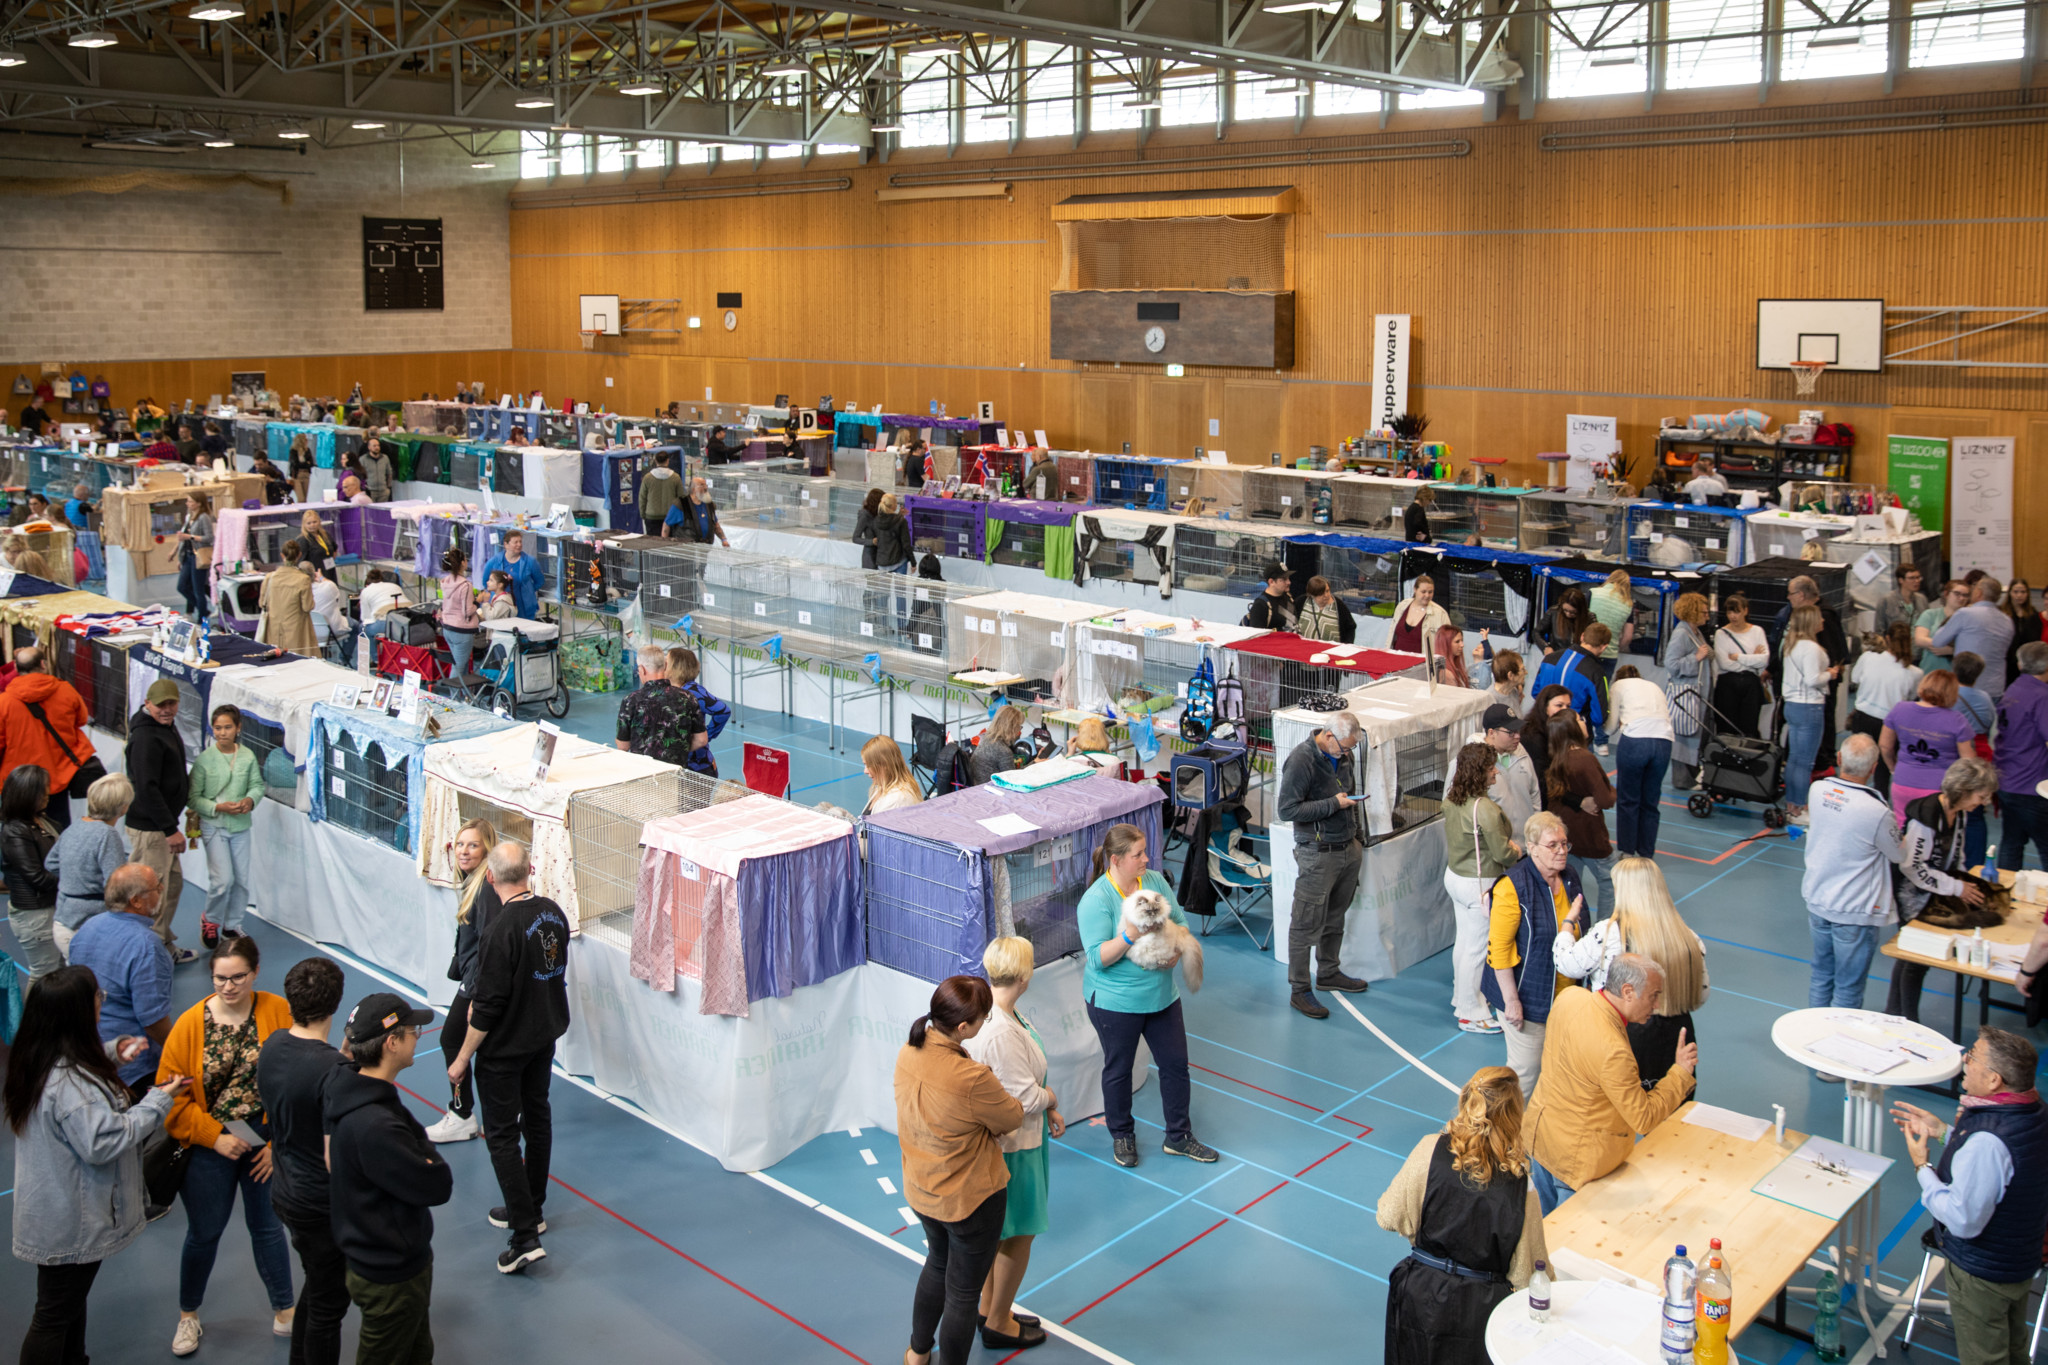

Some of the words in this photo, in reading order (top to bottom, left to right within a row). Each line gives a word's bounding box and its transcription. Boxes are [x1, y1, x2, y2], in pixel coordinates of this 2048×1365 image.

[1382, 320, 1397, 428] Tupperware
[982, 404, 989, 418] E
[803, 413, 814, 428] D
[1704, 1302, 1729, 1317] FANTA
